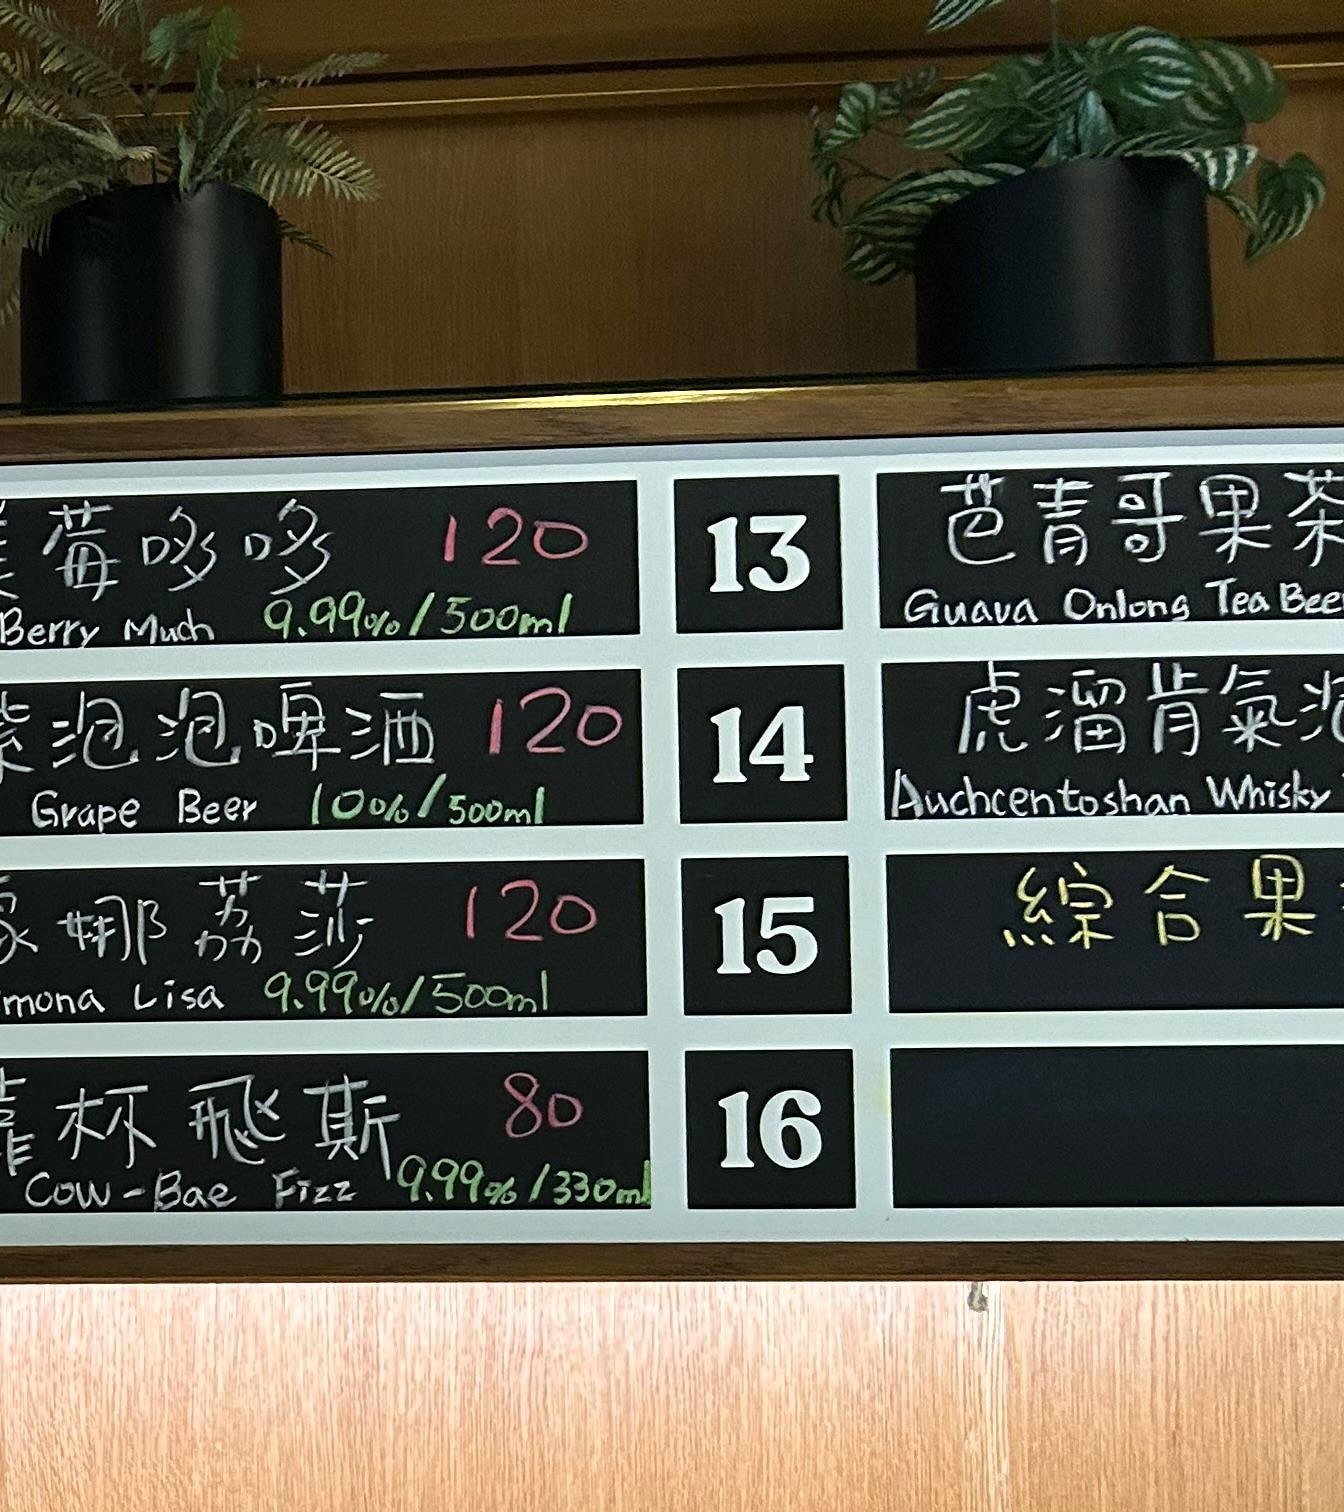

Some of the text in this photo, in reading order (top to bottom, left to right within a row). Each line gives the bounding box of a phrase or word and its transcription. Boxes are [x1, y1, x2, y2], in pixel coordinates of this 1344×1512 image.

[444, 508, 588, 565] 120
[707, 515, 810, 592] 13
[0, 607, 99, 650] Berry
[124, 608, 214, 644] Much
[904, 578, 1344, 625] Guava Onlong Tea Bee
[490, 687, 622, 753] 120
[710, 706, 814, 783] 14
[32, 790, 140, 832] Grape
[179, 788, 257, 824] Beer
[1206, 770, 1331, 810] Whisky
[467, 880, 596, 940] 120
[1001, 852, 1344, 950] 綜合果
[715, 897, 818, 974] 15
[134, 980, 224, 1010] Lisa
[504, 1073, 582, 1137] 80
[718, 1090, 822, 1168] 16
[273, 1168, 356, 1206] Fizz
